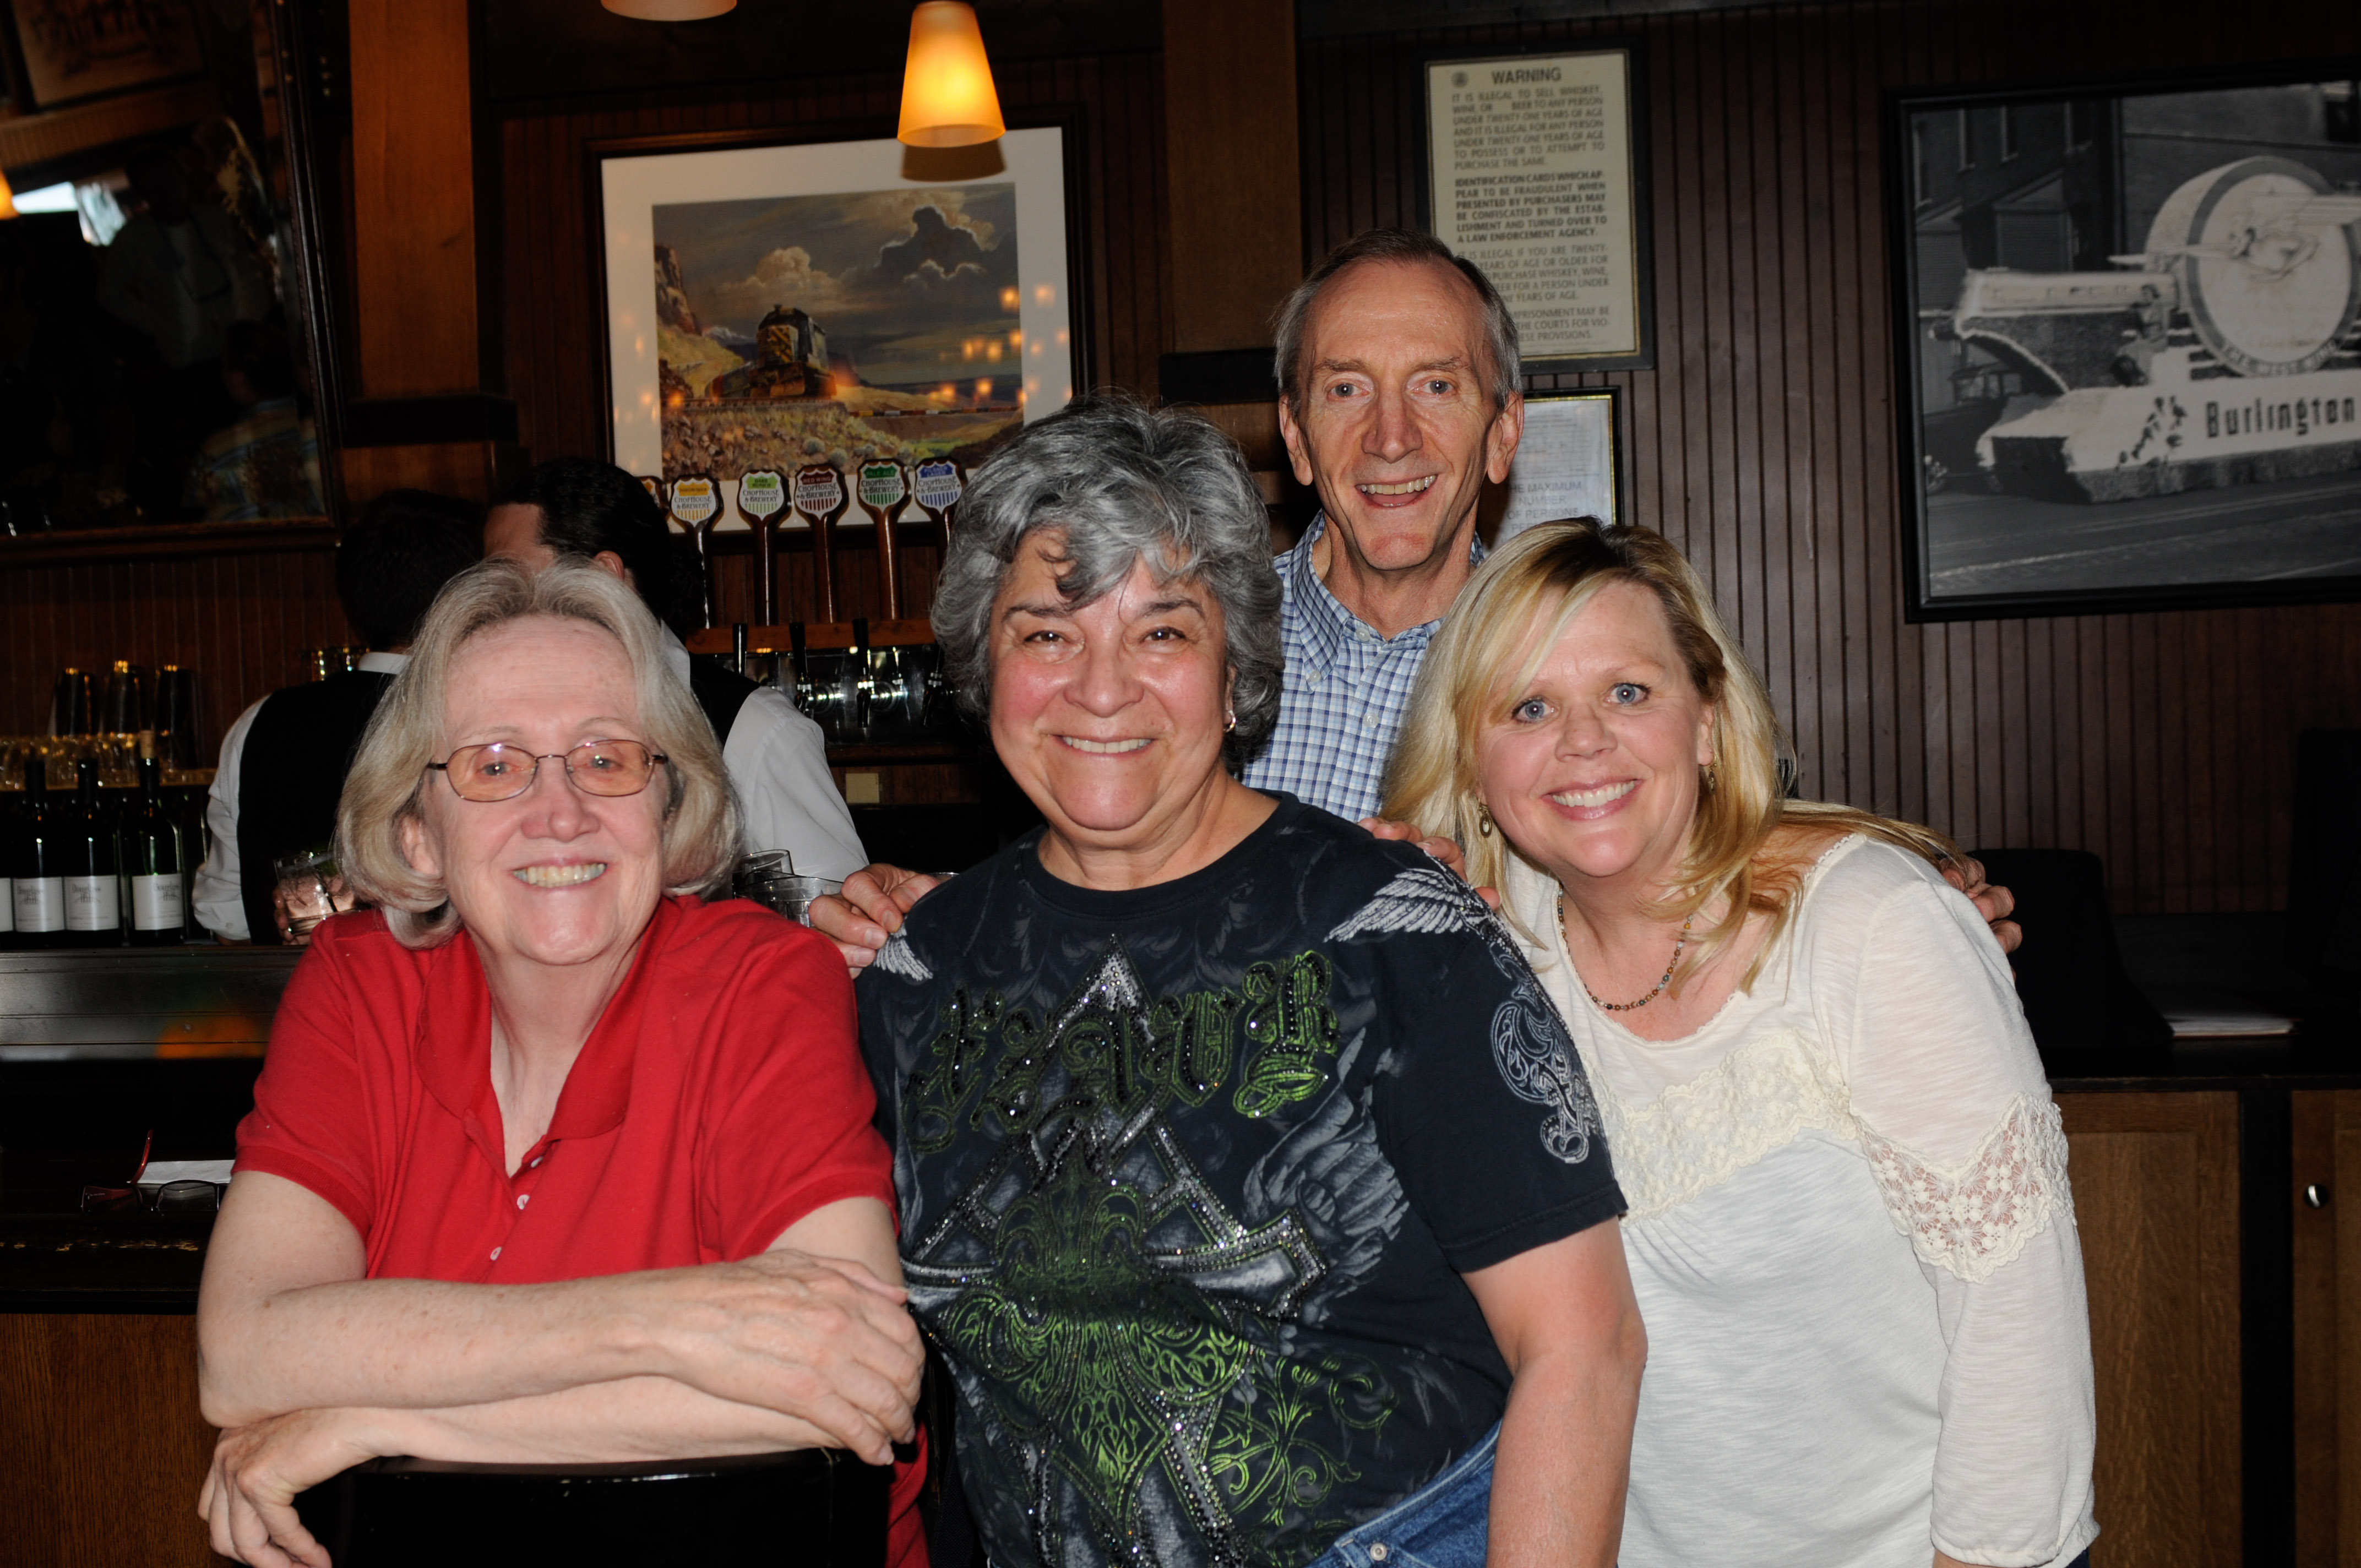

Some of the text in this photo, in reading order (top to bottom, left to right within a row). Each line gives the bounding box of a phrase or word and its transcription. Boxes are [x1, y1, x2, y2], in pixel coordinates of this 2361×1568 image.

[1492, 68, 1561, 84] WARNING
[1452, 93, 1459, 102] IT
[1478, 90, 1511, 101] ILLEGAL
[1518, 89, 1530, 99] TO
[1535, 88, 1553, 98] SELL
[1452, 96, 1602, 113] WINE OR BEER TO ANY PERSON
[1452, 115, 1483, 125] UNDER
[1543, 110, 1568, 120] YEARS
[1571, 109, 1581, 118] OF
[1586, 108, 1602, 118] AGE
[1454, 119, 1603, 136] AND IT IS ILLEGAL FOR ANY PERSON
[1454, 137, 1483, 147] UNDER
[1544, 132, 1569, 142] YEARS
[1571, 132, 1582, 141] OF
[1586, 130, 1603, 140] AGE
[1454, 141, 1604, 158] TO POSSESS OR TO ATTEMPT TO
[1454, 159, 1498, 170] PURCHASE
[1503, 158, 1517, 167] THE
[1455, 174, 1524, 186] IDENTIFICATION
[1526, 172, 1554, 183] CARDS
[1558, 171, 1588, 181] WHICH
[1456, 182, 1605, 198] PEAR TO BE FRAUDULENT WHEN
[1456, 193, 1604, 209] PRESENTED BY PURCHASERS MAY
[1456, 211, 1466, 220] BE
[1472, 208, 1532, 220] CONFISCATED
[1537, 207, 1548, 216] BY
[1554, 206, 1569, 216] THE
[1457, 216, 1607, 231] LISHMENT AND TURNED OVER TO
[1457, 235, 1463, 243] A
[1466, 233, 1487, 243] LAW
[1490, 230, 1554, 242] ENFORCEMENT
[1480, 248, 1513, 258] ILLEGAL
[1517, 247, 1524, 257] IF
[1528, 246, 1547, 256] YOU
[1551, 246, 1565, 255] ARE
[1508, 259, 1518, 268] OF
[1523, 258, 1539, 268] AGE
[1543, 258, 1554, 267] OR
[1559, 256, 1587, 266] OLDER
[1591, 255, 1608, 265] FOR
[1492, 269, 1536, 280] PURCHASE
[1497, 278, 1608, 291] EER FOR A PERSON UNDER
[1517, 292, 1541, 302] YEARS
[1544, 291, 1555, 301] OF
[1577, 307, 1595, 316] MAY
[1600, 306, 1608, 315] BE
[1534, 319, 1569, 329] COURTS
[1573, 319, 1588, 328] FOR
[1520, 331, 1533, 341] ESE
[2206, 397, 2355, 438] Burlington
[1528, 481, 1582, 493] MAXIMUM
[1506, 507, 1579, 520] OF PERSONS
